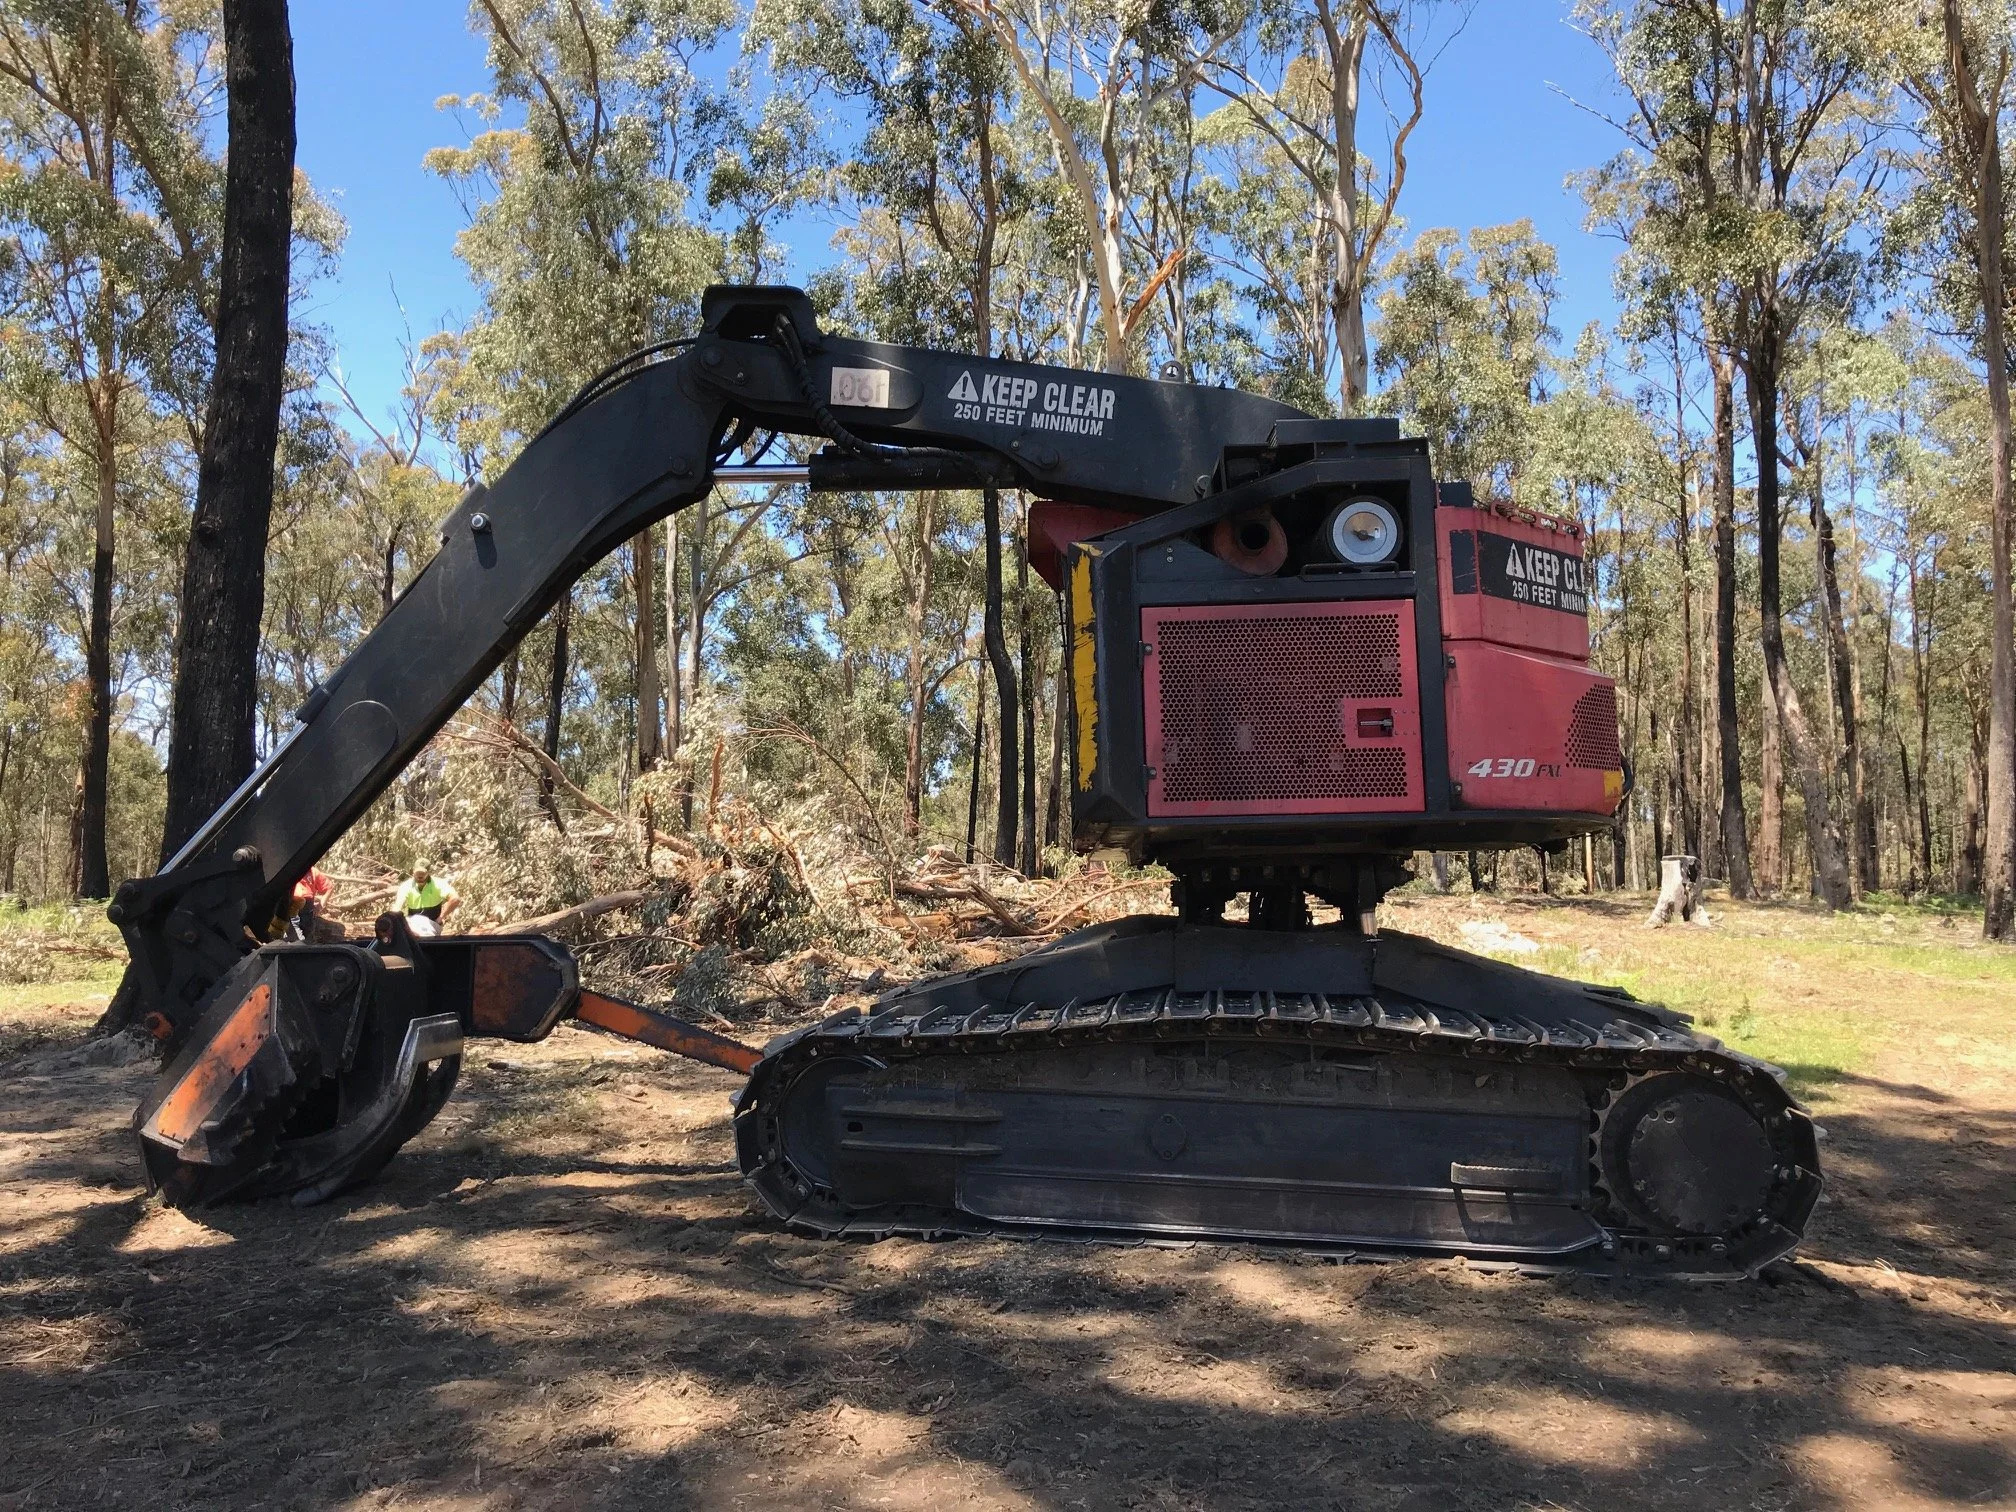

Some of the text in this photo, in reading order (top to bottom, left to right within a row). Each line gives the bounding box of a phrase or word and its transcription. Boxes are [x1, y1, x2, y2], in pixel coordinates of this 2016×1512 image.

[981, 373, 1116, 420] KEEP CLEAR
[954, 402, 1103, 436] 250 FEET MINIMUM
[1525, 547, 1559, 586] KEEP
[1512, 580, 1528, 601] 250
[1532, 585, 1557, 606] FEET
